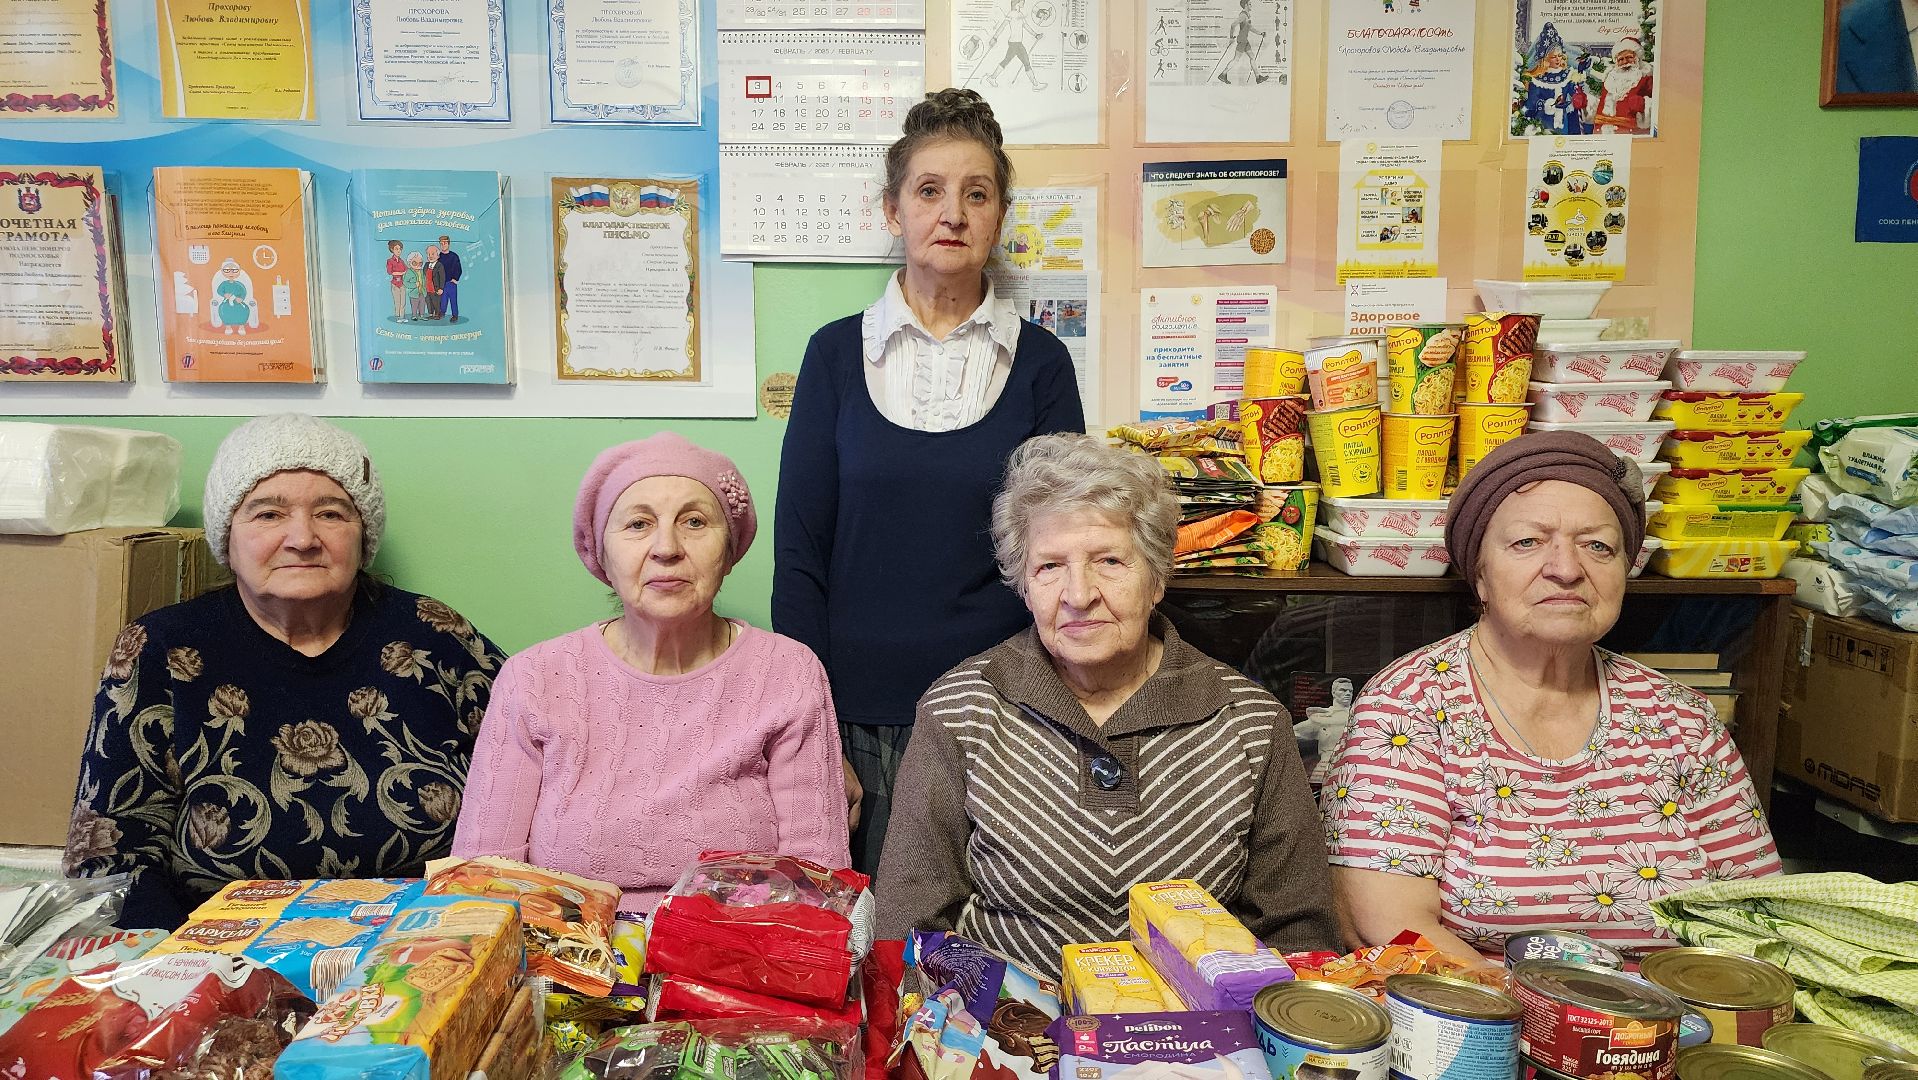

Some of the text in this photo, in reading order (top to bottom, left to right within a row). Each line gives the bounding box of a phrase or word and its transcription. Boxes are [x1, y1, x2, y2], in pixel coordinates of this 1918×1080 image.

[792, 7, 806, 16] 25
[814, 7, 828, 16] 26
[835, 7, 849, 16] 27
[857, 7, 871, 16] 28
[183, 15, 214, 23] Любовь
[1597, 26, 1640, 35] Дед Мороз
[862, 68, 890, 77] 1 2
[754, 81, 890, 91] 3 4 5 6 7 8 9
[752, 95, 894, 106] 10 11 12 13 14 15 16
[751, 109, 894, 119] 17 18 19 20 21 22 23
[751, 123, 851, 131] 24 25 26 27 28
[1150, 172, 1165, 180] ЧТО
[1196, 171, 1218, 179] ЗНАТЬ
[1228, 169, 1280, 178] ОСТЕОПОРОЗЕ?
[862, 181, 868, 190] 1
[755, 194, 762, 203] 3
[776, 194, 784, 203] 4
[798, 194, 805, 203] 5
[819, 194, 826, 203] 6
[840, 194, 847, 203] 7
[371, 206, 475, 222] Нотная азбука здоровья
[753, 208, 872, 217] 10 11 12 13 14 15
[0, 218, 77, 230] ОЧЕТНАЯ
[377, 219, 471, 233] для пожилого человека
[582, 221, 671, 230] БЛАГОДАРСТВЕННОЕ
[753, 221, 766, 230] 17
[774, 221, 787, 230] 18
[795, 221, 808, 230] 19
[816, 221, 831, 230] 20
[838, 221, 851, 230] 21
[859, 222, 873, 231] 22
[603, 231, 650, 240] ПИСЬМО
[752, 234, 852, 244] 24 25 26 27 28
[1151, 314, 1197, 324] Активное
[1350, 311, 1421, 323] Здоровое
[1152, 322, 1198, 330] долголетие
[1350, 326, 1387, 335] долг
[375, 326, 395, 338] Семь
[1153, 346, 1195, 354] приходите
[1156, 353, 1203, 361] бесплатные
[1325, 354, 1361, 369] Роллтон
[1566, 361, 1607, 382] Доширак
[1620, 358, 1663, 377] Доширак
[1709, 368, 1752, 388] Доширак
[1595, 396, 1635, 417] Доширак
[1343, 415, 1380, 433] Роллтон
[1487, 416, 1528, 429] Роллтон
[1343, 441, 1364, 450] ЛАПША
[1416, 449, 1437, 457] ЛАПША
[1377, 514, 1419, 538] Доширак
[232, 888, 297, 898] КАРУСЕЛИ
[1148, 889, 1205, 902] КРЕКЕР
[185, 927, 255, 939] КАРУСЕЛИ
[1074, 954, 1134, 967] КРЕКЕР
[1088, 965, 1137, 973] КУНЖУТОМ
[1580, 1016, 1613, 1026] 32125-2013
[1124, 1023, 1183, 1033] Delibon
[1102, 1037, 1214, 1052] Пастила
[1123, 1051, 1197, 1059] СМОРОДИНА
[1596, 1049, 1660, 1066] Говядина
[1561, 1064, 1572, 1072] 325
